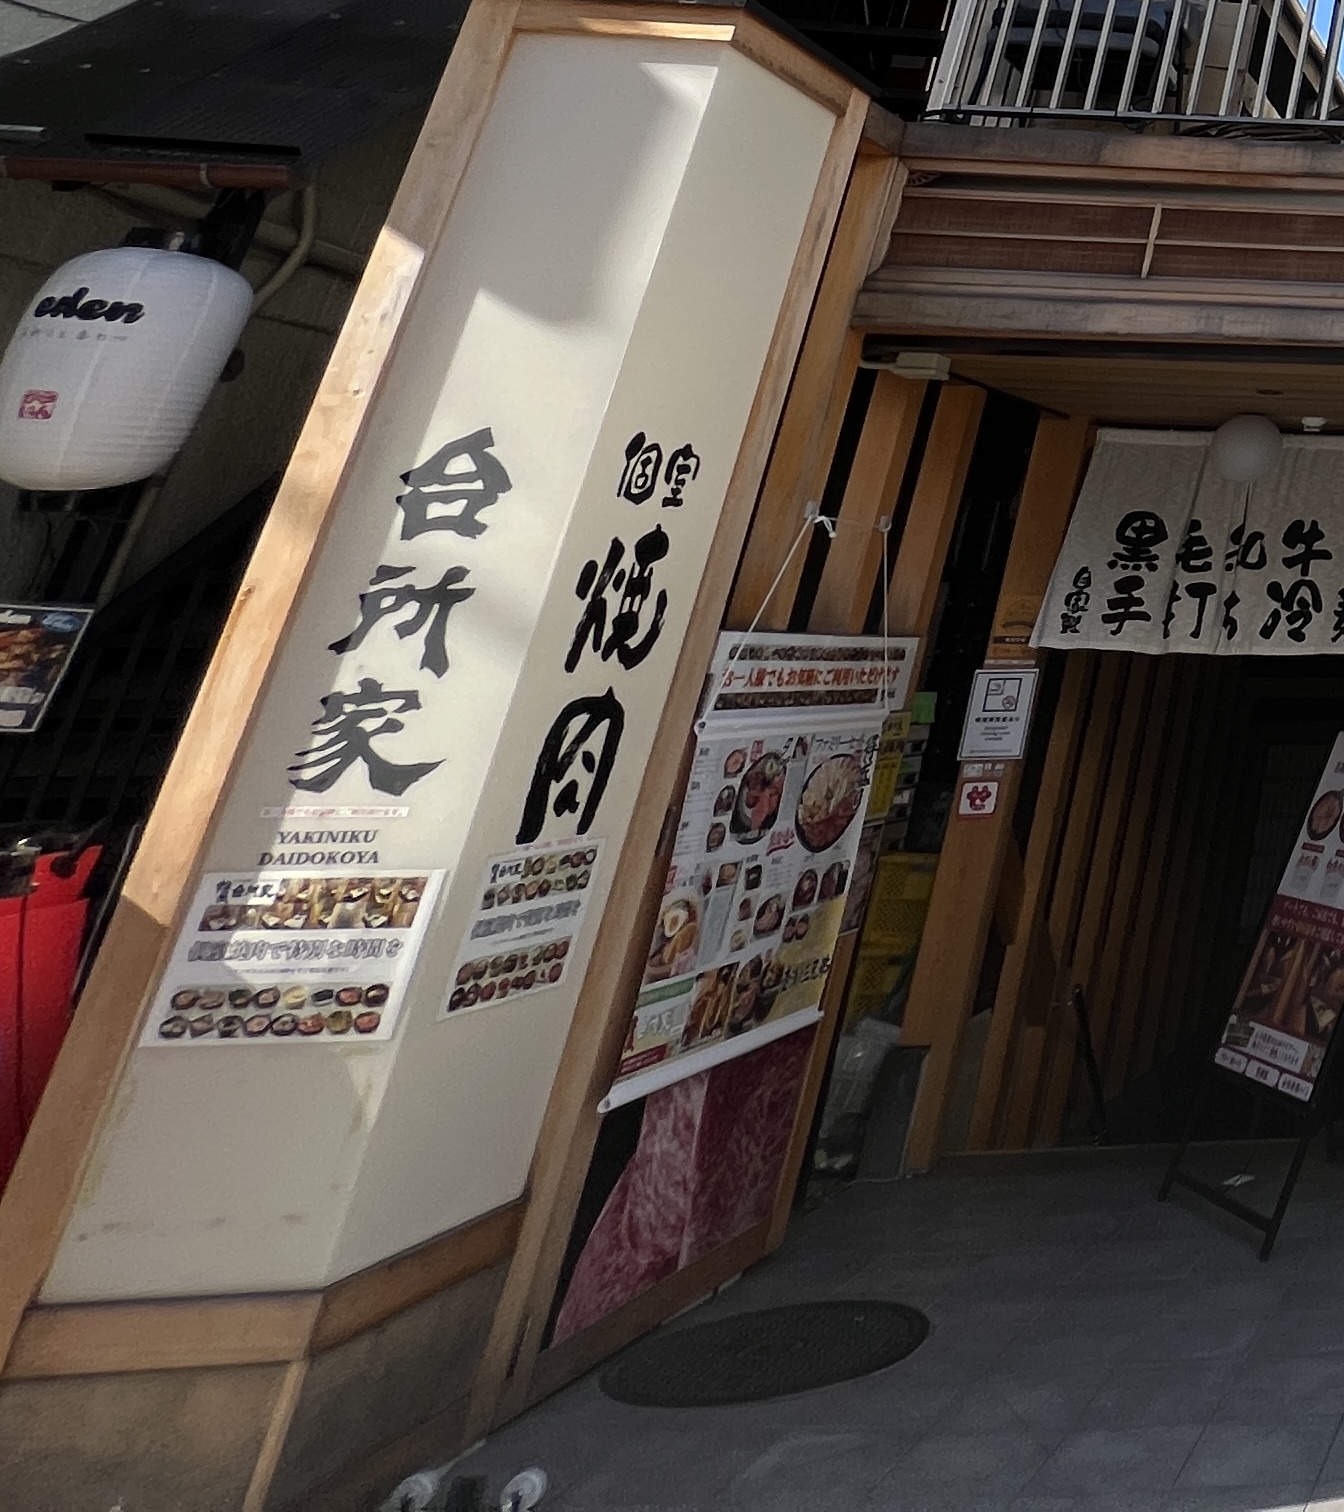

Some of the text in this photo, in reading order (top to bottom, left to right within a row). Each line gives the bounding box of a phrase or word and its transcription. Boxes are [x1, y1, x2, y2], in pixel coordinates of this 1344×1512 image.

[616, 430, 702, 508] 個室
[288, 427, 513, 798] 台所家
[515, 524, 670, 846] 焼肉
[257, 851, 380, 866] DAIDOKOYA
[277, 829, 380, 844] YAKINIKU
